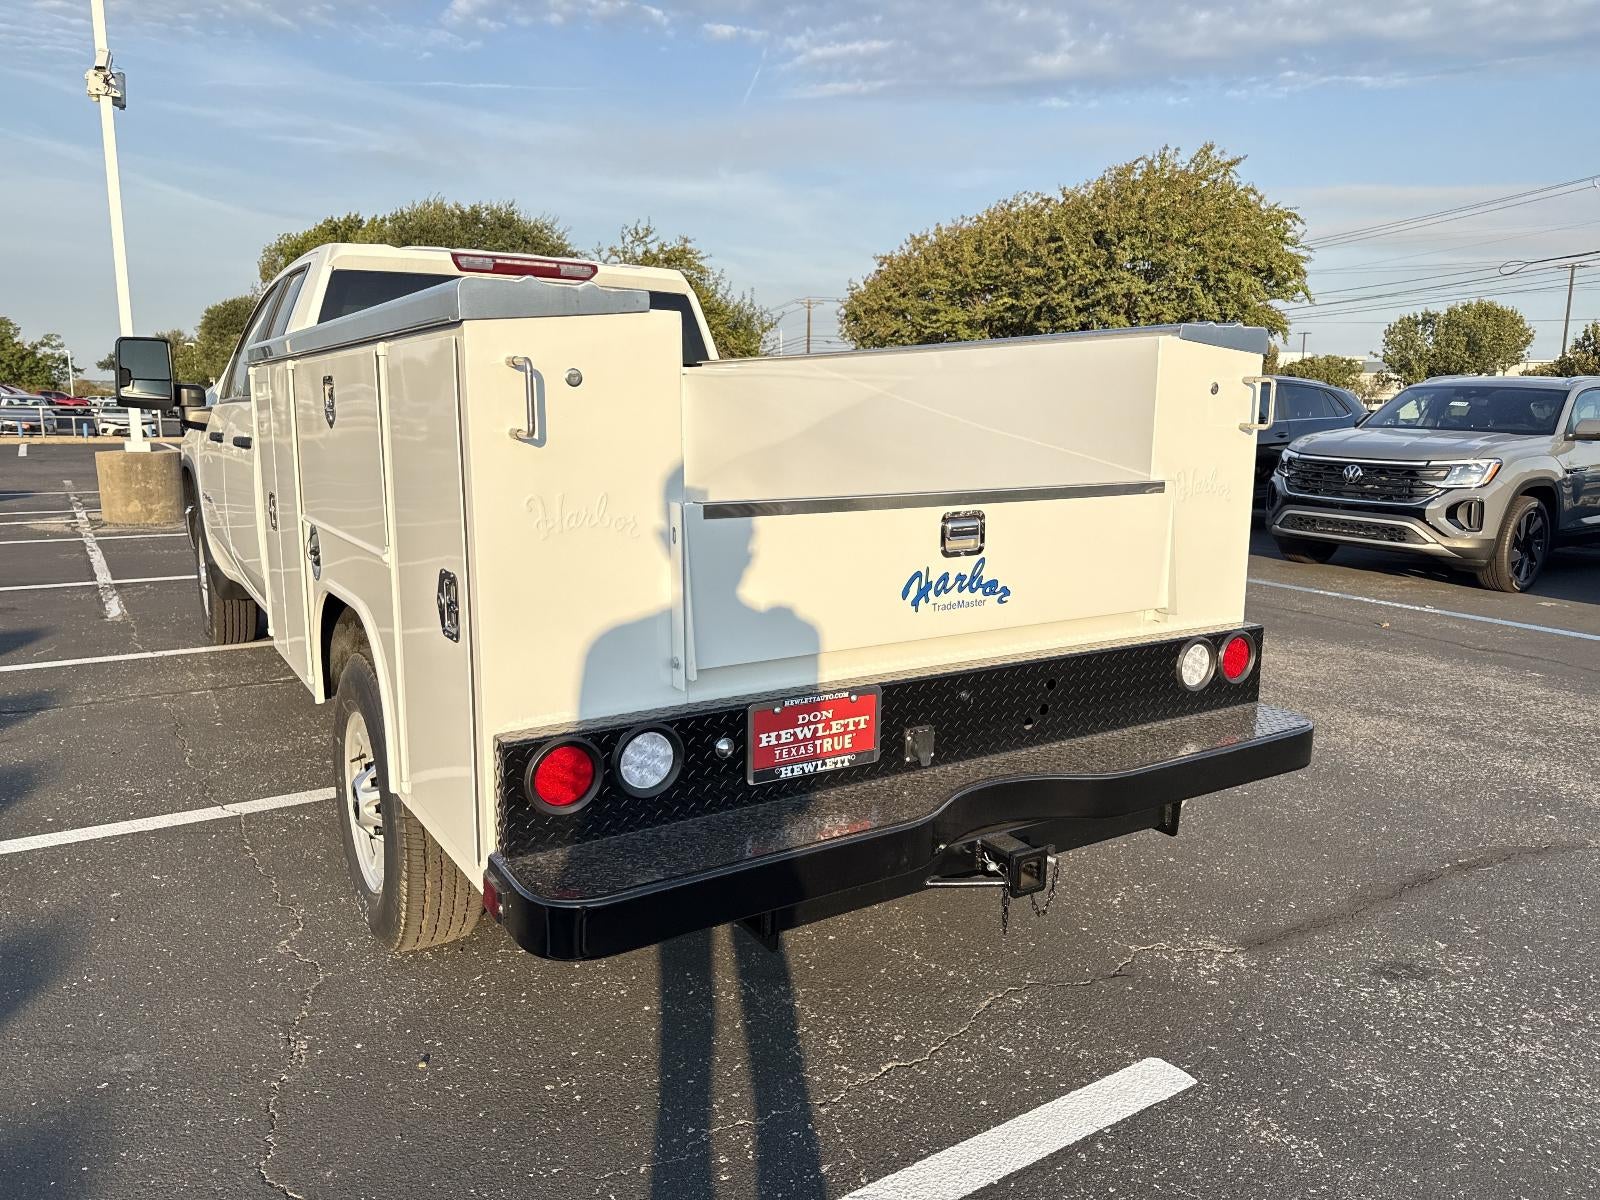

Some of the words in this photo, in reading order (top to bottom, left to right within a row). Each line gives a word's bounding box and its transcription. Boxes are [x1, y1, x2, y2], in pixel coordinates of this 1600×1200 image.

[525, 491, 640, 541] Harbor
[901, 556, 1011, 613] Harbor
[932, 599, 986, 612] TradeMaster
[784, 691, 849, 707] HEWLETTAUTO.COM
[797, 709, 833, 724] DON
[759, 715, 870, 748] HEWLETT
[779, 754, 851, 778] HEWLETT
